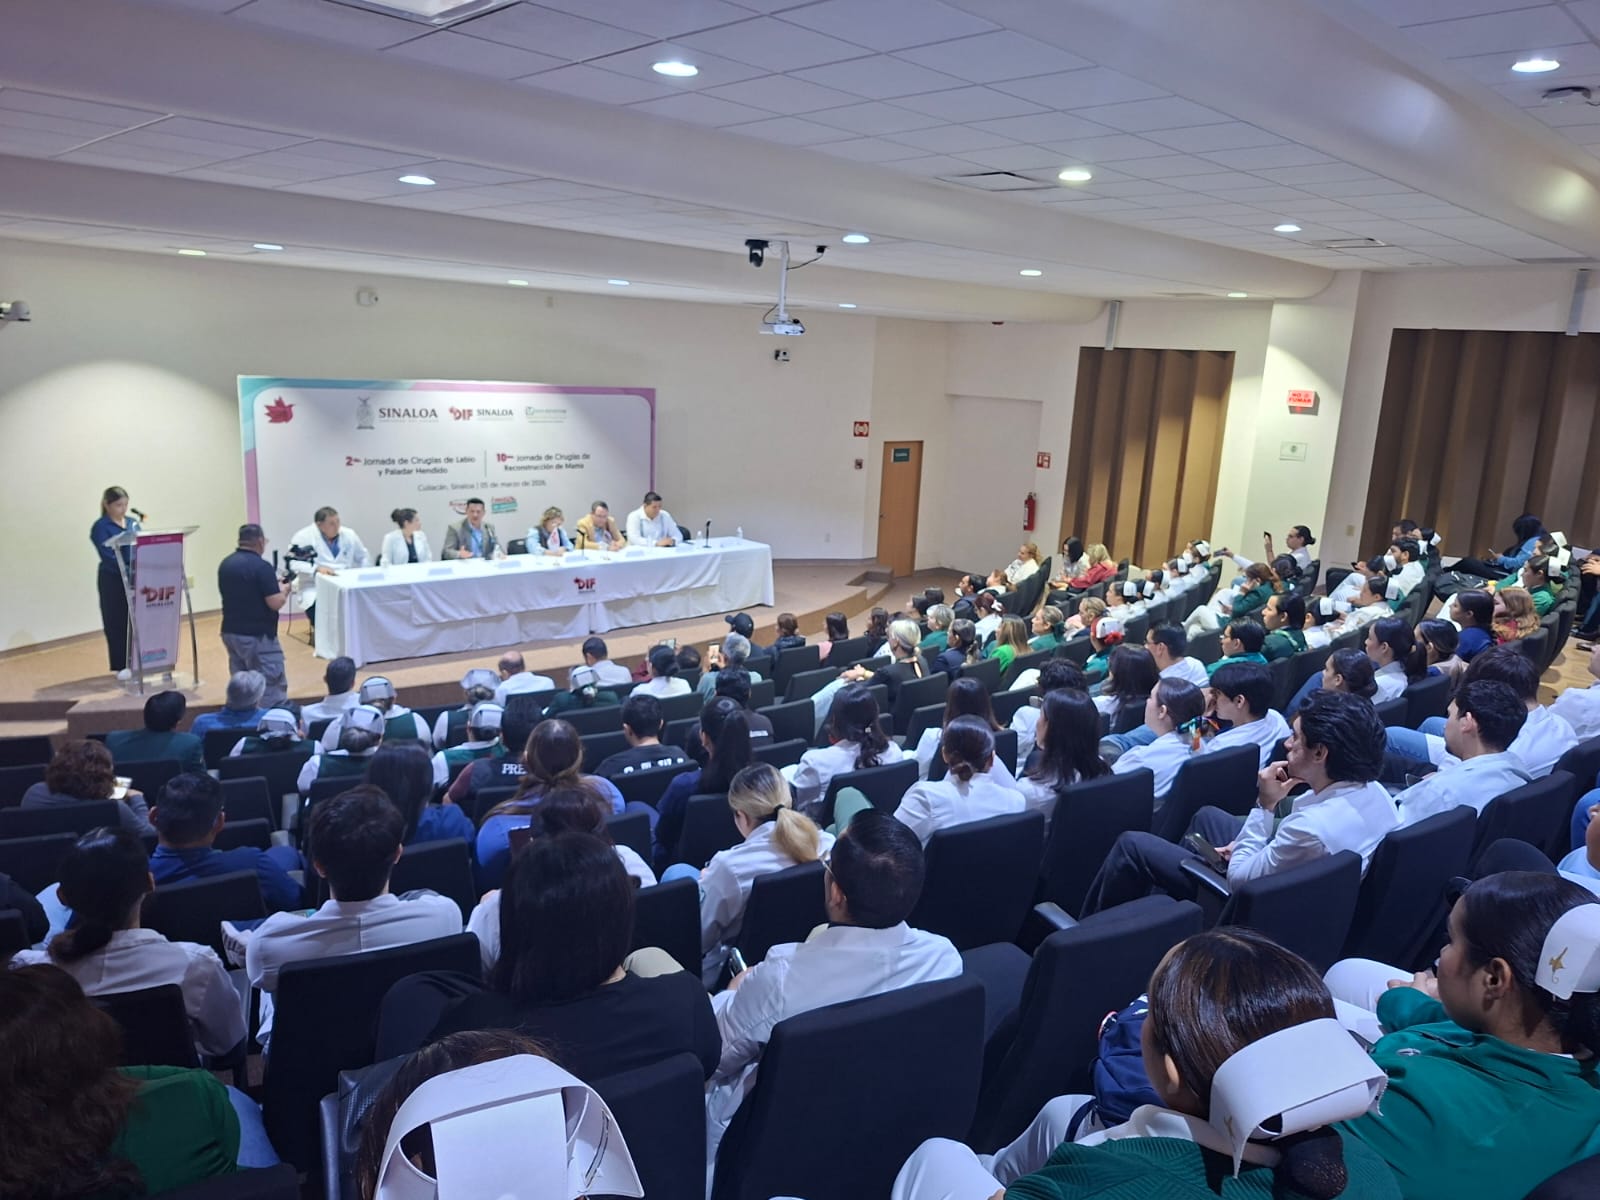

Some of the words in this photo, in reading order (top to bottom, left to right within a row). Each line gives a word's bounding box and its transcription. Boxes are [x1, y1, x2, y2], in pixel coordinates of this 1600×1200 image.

[378, 408, 438, 419] SINALOA
[453, 408, 473, 420] DIF
[476, 408, 514, 417] SINALOA
[363, 457, 396, 466] Jornada
[398, 457, 408, 465] de
[443, 456, 454, 464] de
[516, 454, 543, 462] Jornada
[578, 578, 596, 589] DIF
[145, 587, 175, 602] DIF
[501, 763, 528, 775] PRE
